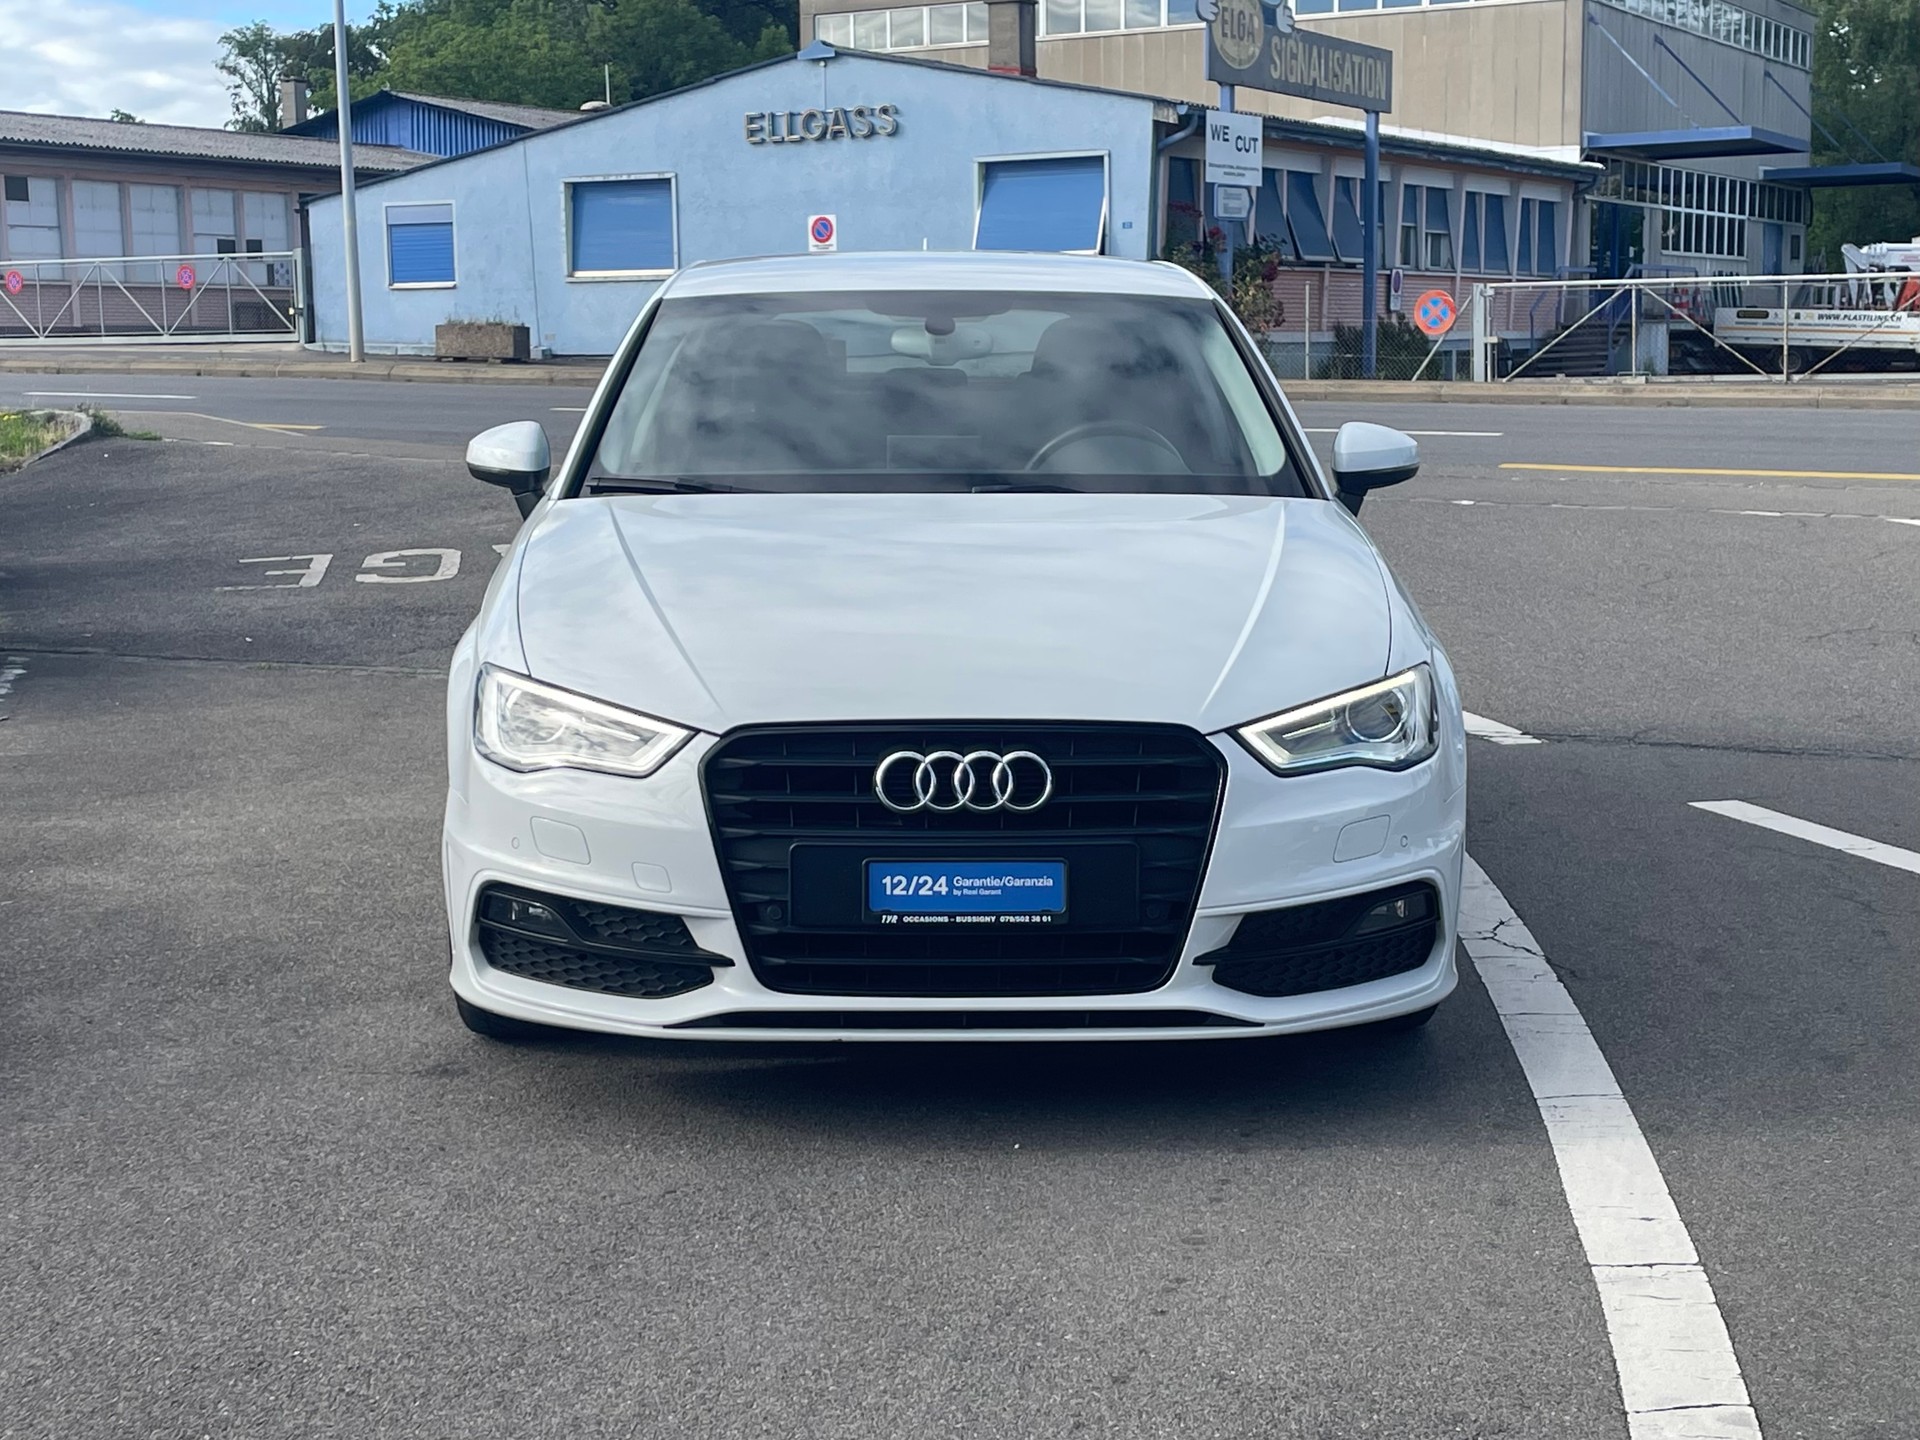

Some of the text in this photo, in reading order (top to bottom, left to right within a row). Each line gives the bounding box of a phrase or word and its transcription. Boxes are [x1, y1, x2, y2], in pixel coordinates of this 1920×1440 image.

[1221, 6, 1256, 44] ELGA
[1270, 35, 1387, 100] SIGNALISATION
[744, 104, 899, 143] ELLGASS
[1210, 123, 1259, 153] WE CUT
[882, 876, 1053, 895] 12/24 Garantie/Garanzia
[953, 888, 962, 896] by
